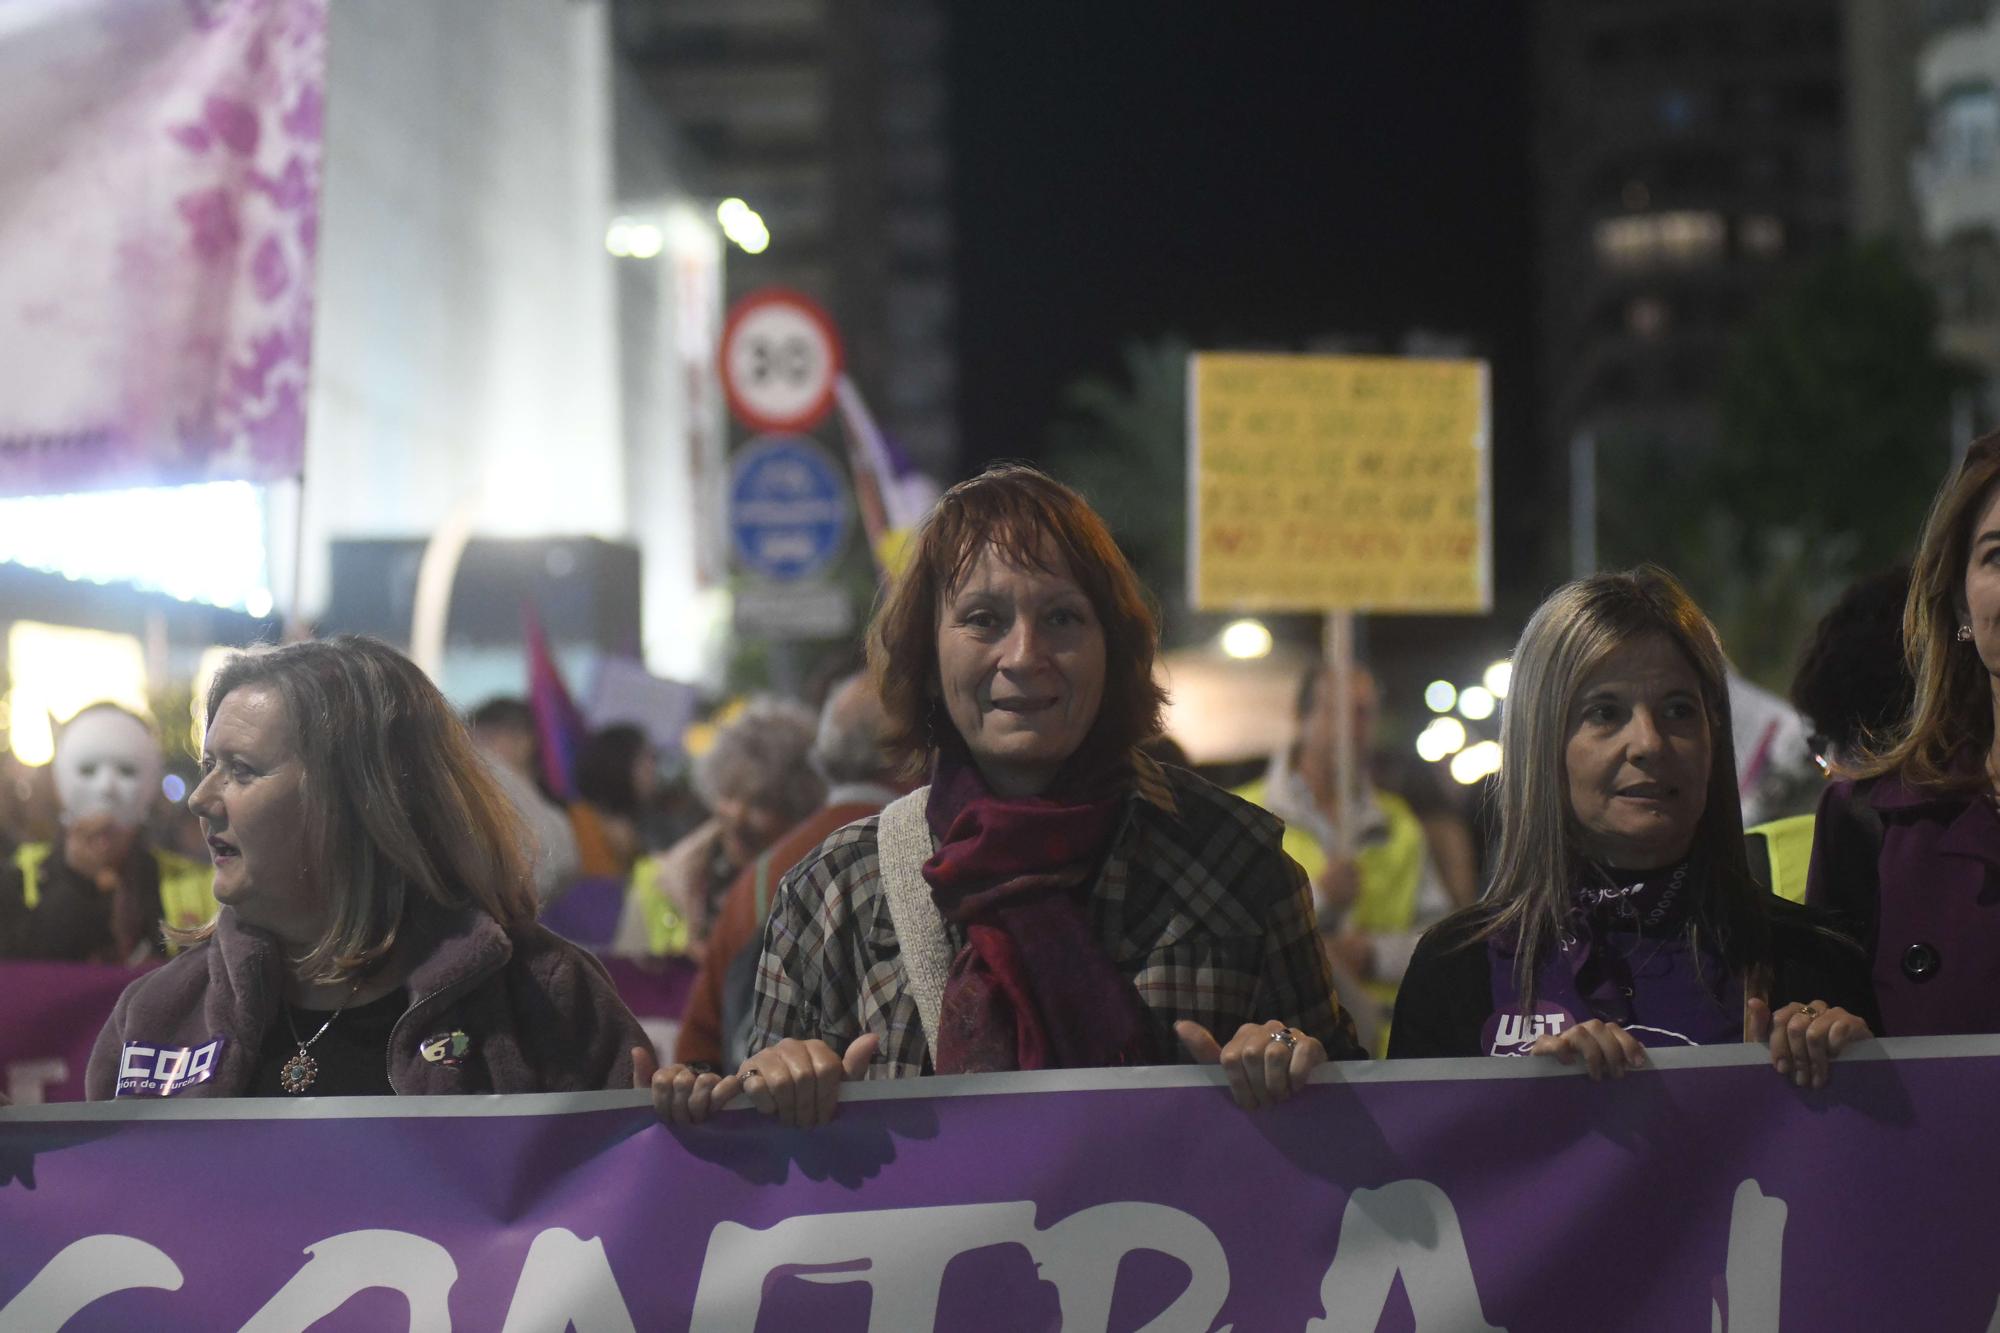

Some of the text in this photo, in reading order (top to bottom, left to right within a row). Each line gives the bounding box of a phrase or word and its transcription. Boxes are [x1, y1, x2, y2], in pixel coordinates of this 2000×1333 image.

[1495, 1013, 1565, 1043] UGT
[119, 1079, 137, 1089] ión
[140, 1079, 156, 1089] de
